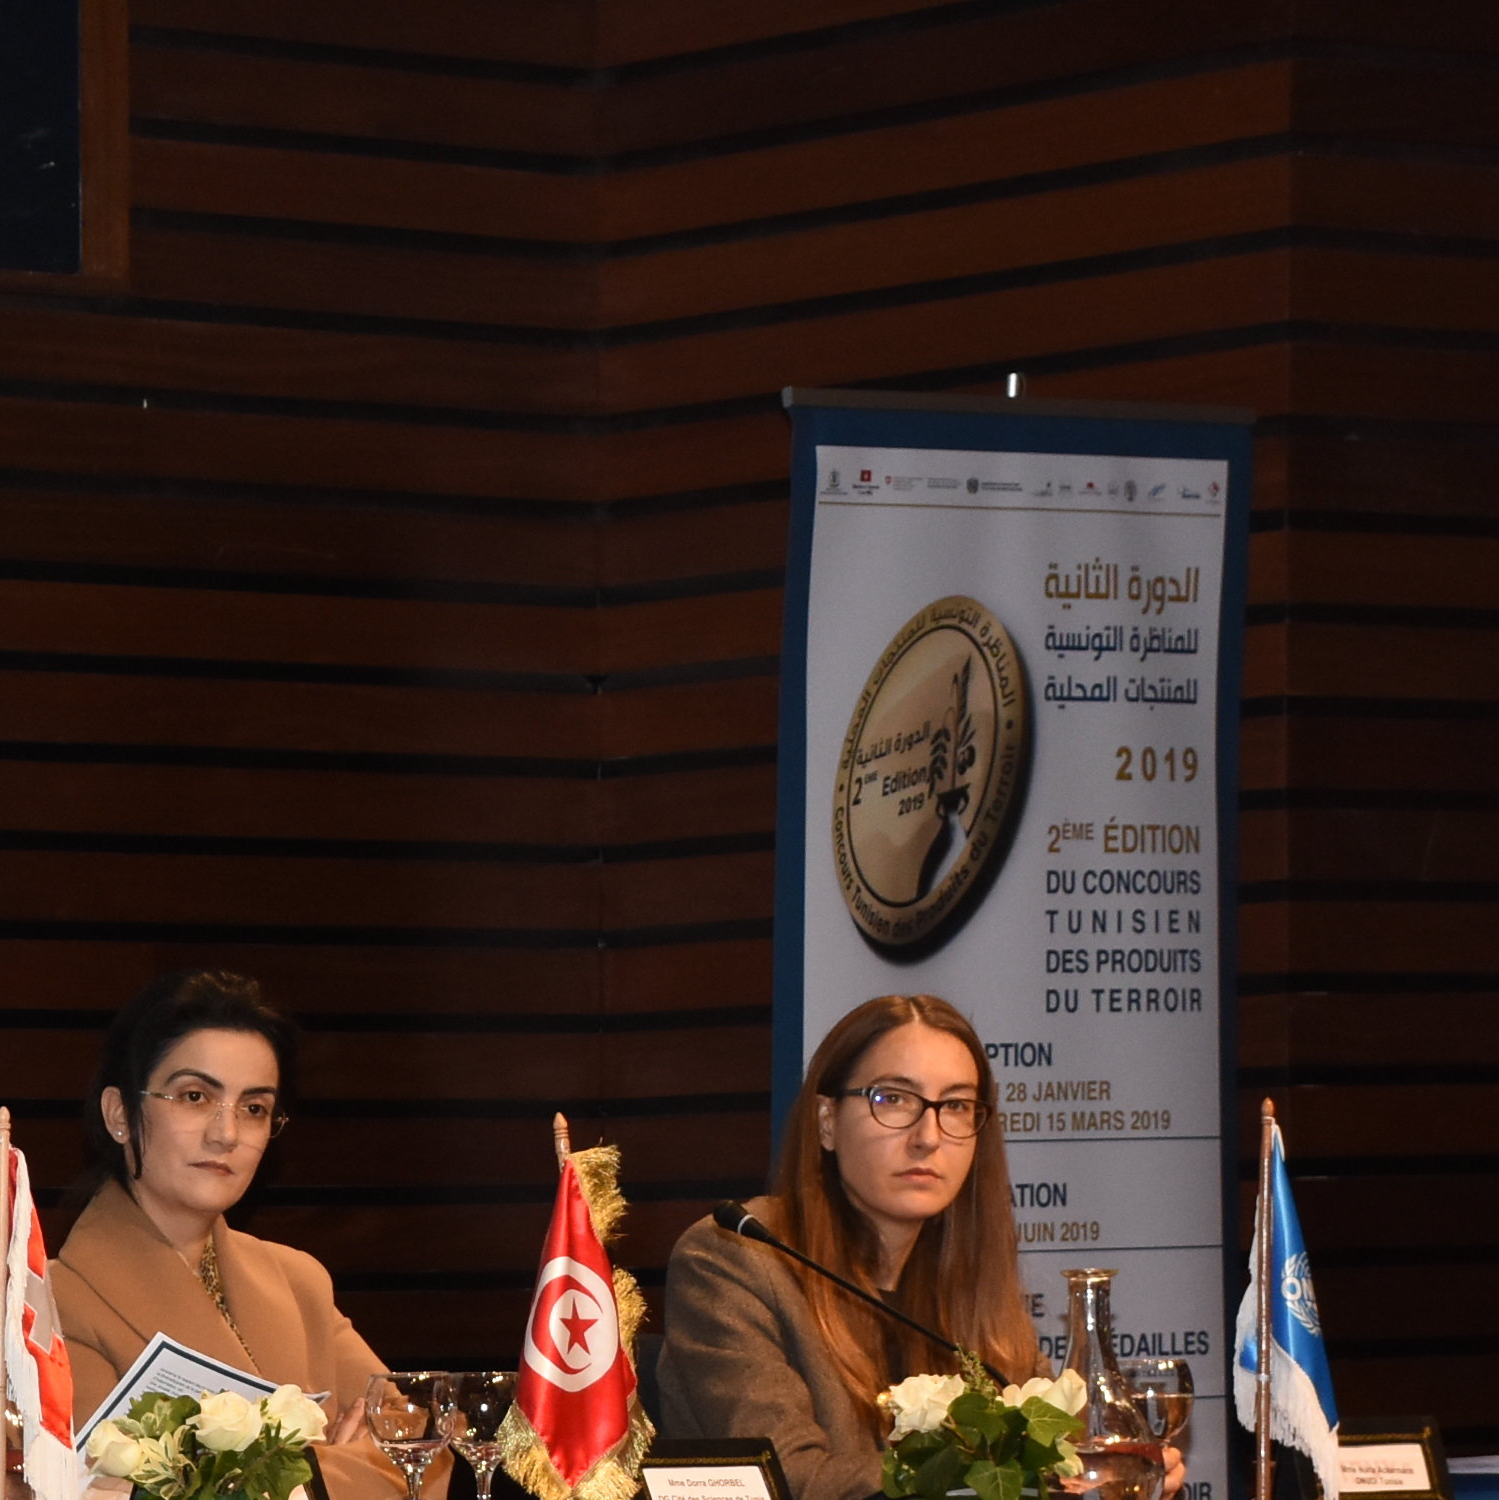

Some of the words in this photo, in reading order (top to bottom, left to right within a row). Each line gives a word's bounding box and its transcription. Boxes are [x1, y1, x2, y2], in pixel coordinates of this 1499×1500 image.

[1044, 557, 1119, 611] الثانية
[1127, 566, 1200, 615] الدورة
[1044, 624, 1123, 661] التونسية
[1129, 627, 1199, 663] للمناظرة
[1044, 675, 1117, 710] المحلية
[1124, 677, 1199, 711] للمنتجات
[1115, 746, 1199, 783] 2019
[897, 793, 925, 817] 2019
[1103, 816, 1201, 854] ÉDITION
[1046, 870, 1076, 895] DU
[1083, 869, 1201, 895] CONCOURS
[1045, 909, 1202, 934] TUNISIEN
[1046, 950, 1089, 974] DES
[1096, 949, 1202, 973] PRODUITS
[1046, 989, 1079, 1014] DU
[1092, 987, 1203, 1013] TERROIR
[985, 1041, 1053, 1069] PTION
[1006, 1083, 1028, 1104] 28
[1032, 1080, 1112, 1103] JANVIER
[1046, 1111, 1067, 1133] 15
[1071, 1109, 1126, 1132] MARS
[1130, 1109, 1172, 1131] 2019
[1060, 1220, 1101, 1243] 2019
[1108, 1331, 1210, 1359] ÉDAILLES
